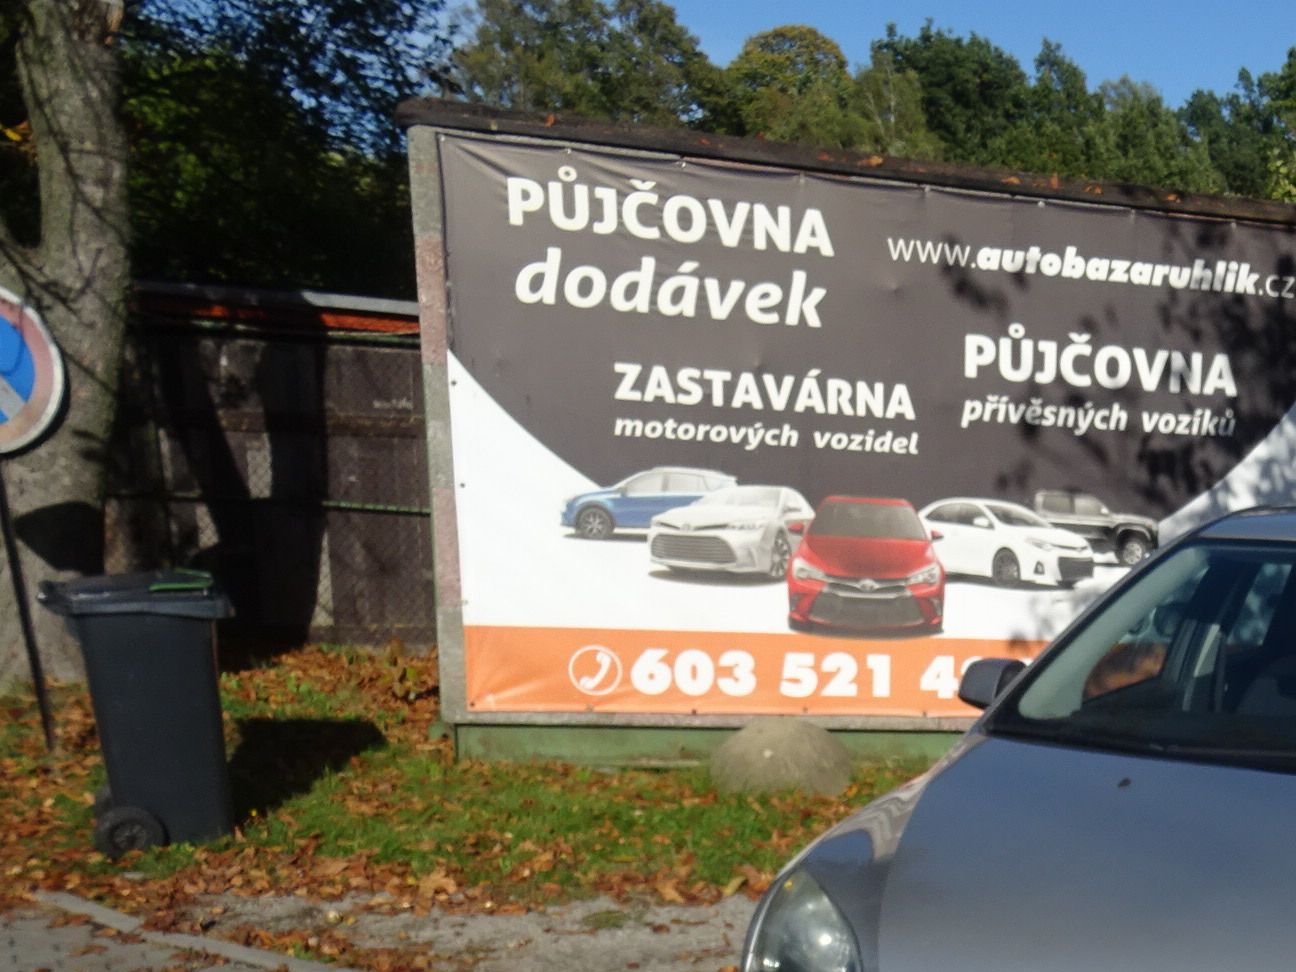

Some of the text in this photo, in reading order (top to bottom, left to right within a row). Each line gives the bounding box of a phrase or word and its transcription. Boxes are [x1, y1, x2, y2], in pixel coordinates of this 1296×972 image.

[507, 166, 835, 257] PŮJČOVNA
[515, 247, 827, 328] dodávek
[887, 237, 1296, 299] www.autobazaruhlik.cz
[963, 323, 1238, 397] PŮJČOVNA
[613, 362, 916, 421] ZASTAVÁRNA
[960, 394, 1236, 438] přívěsných vozíků
[614, 416, 919, 455] motorových vozidel
[630, 647, 757, 697] 603
[779, 652, 891, 698] 521
